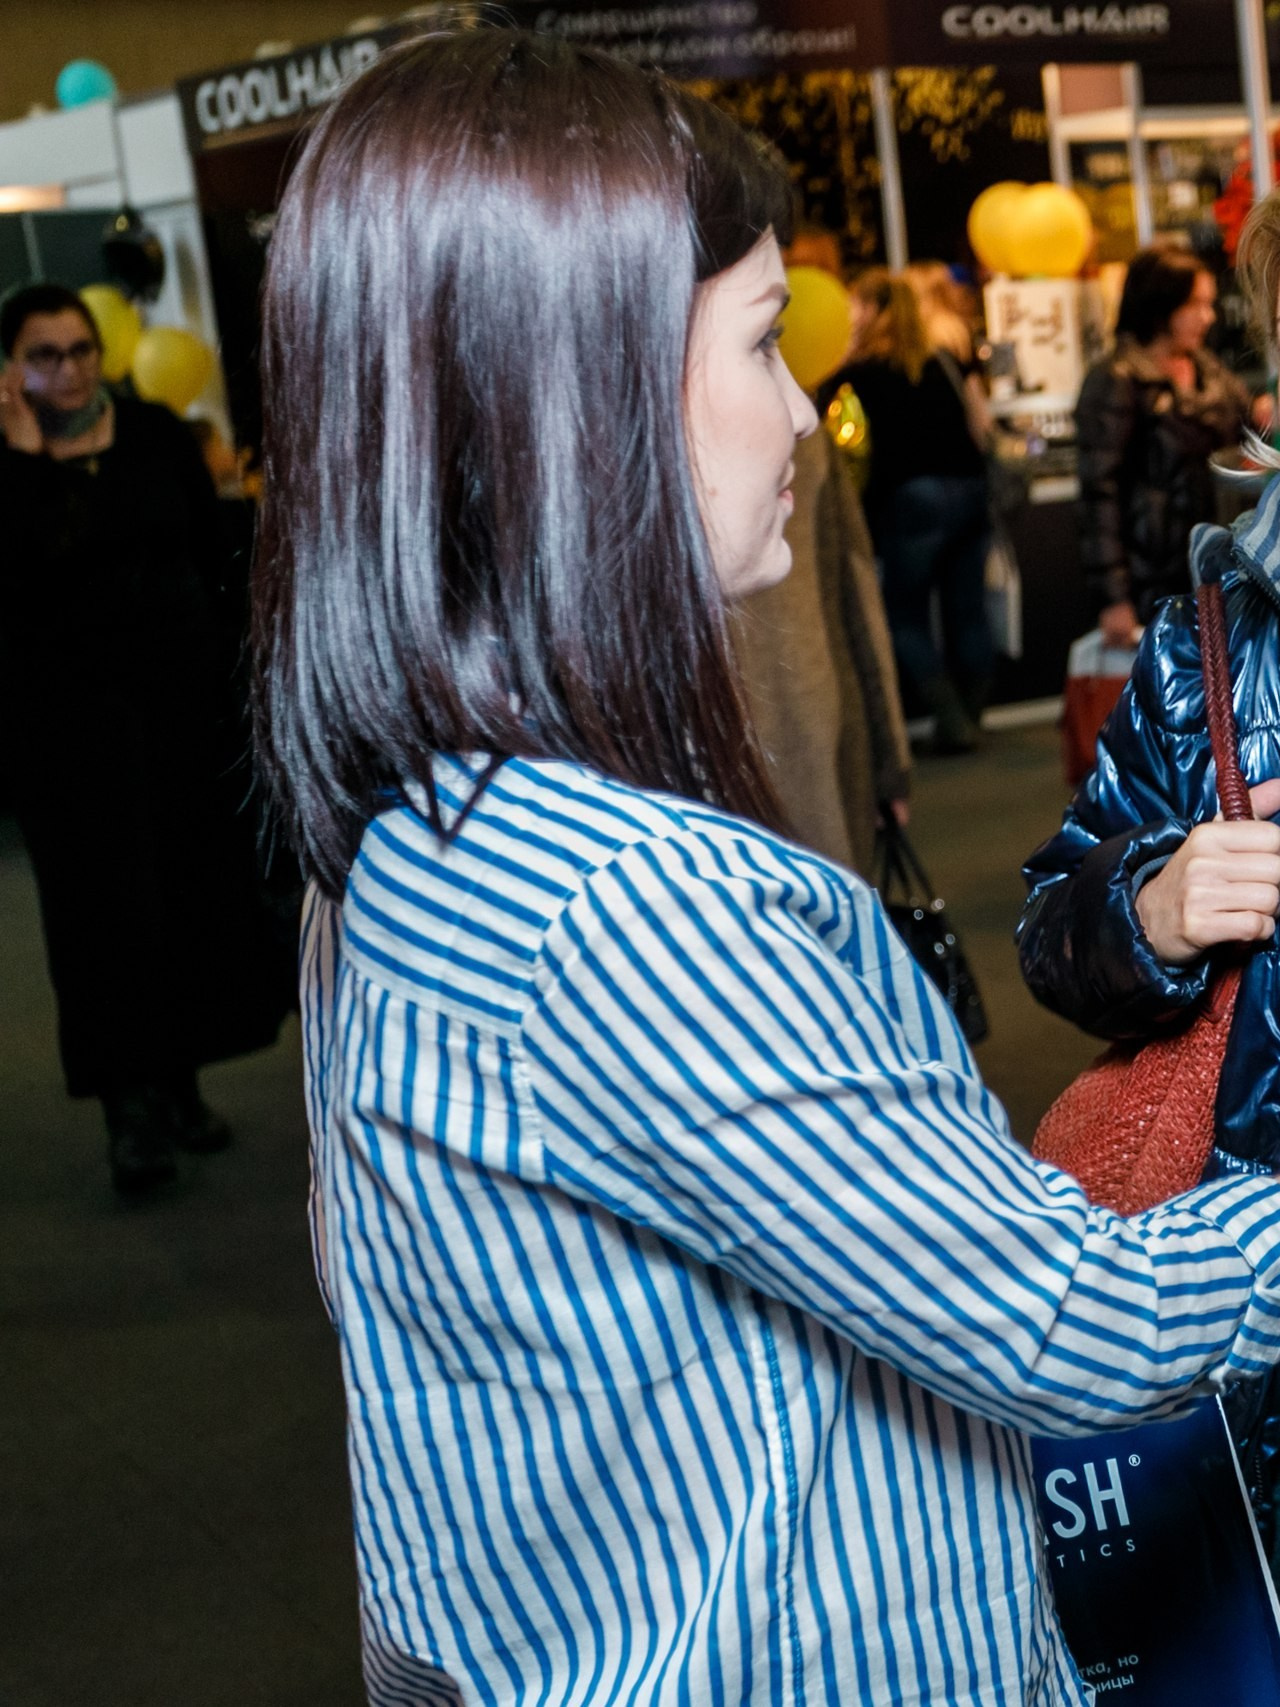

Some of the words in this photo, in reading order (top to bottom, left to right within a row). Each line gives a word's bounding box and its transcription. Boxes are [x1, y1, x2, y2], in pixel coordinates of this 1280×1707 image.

[942, 4, 1170, 37] COOLHAIR
[1056, 1538, 1136, 1569] TICS
[1118, 1654, 1139, 1668] но
